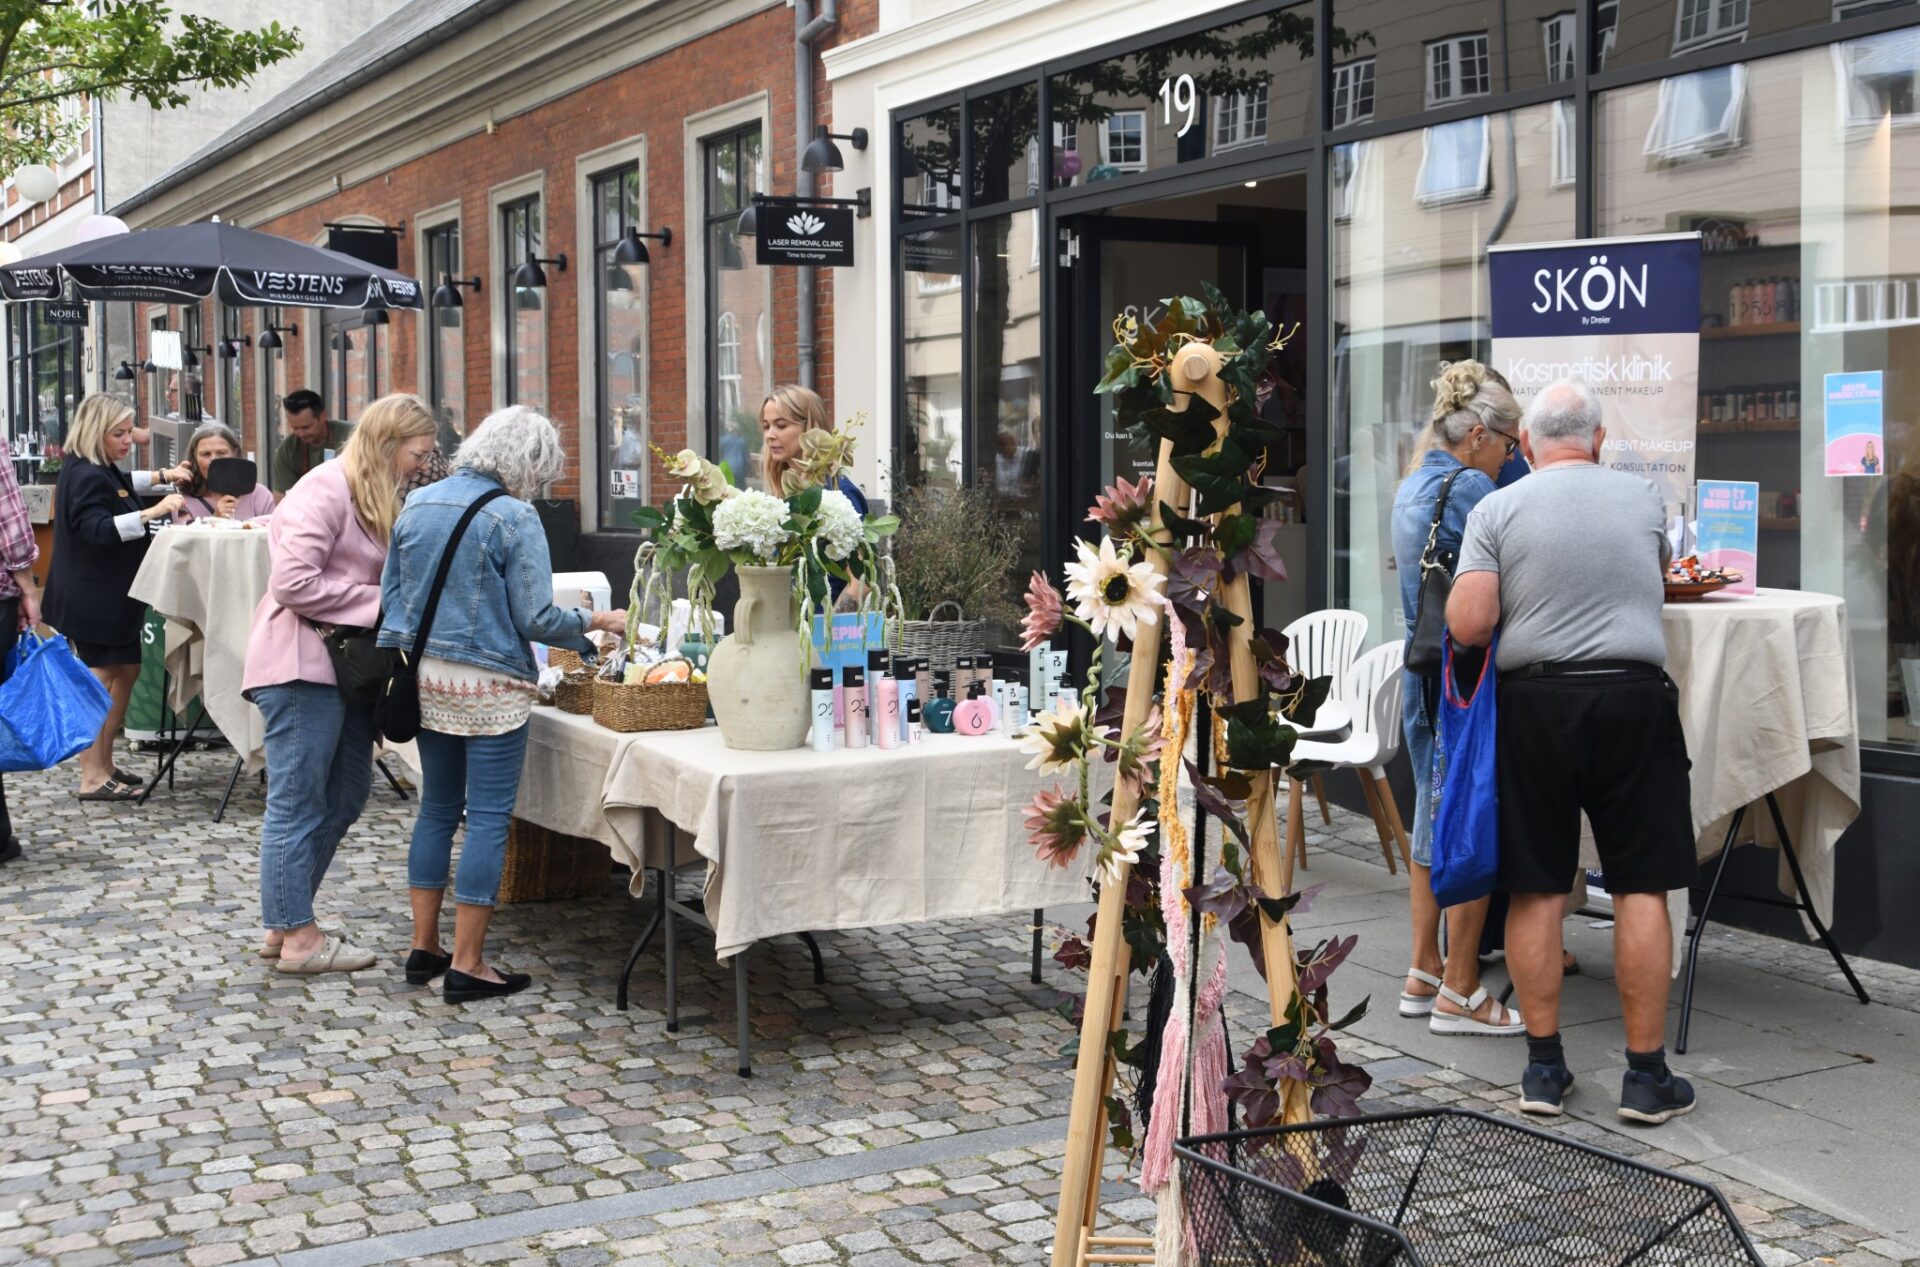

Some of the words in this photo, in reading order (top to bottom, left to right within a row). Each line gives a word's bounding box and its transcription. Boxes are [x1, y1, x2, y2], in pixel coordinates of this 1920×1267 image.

[1159, 73, 1195, 138] 19
[768, 238, 790, 246] LASER
[790, 239, 821, 247] REMOVAL
[821, 240, 844, 248] CLINIC
[806, 252, 826, 260] change
[1531, 255, 1648, 314] SKÖN
[49, 309, 82, 319] NOBEL
[1581, 316, 1590, 326] By
[1590, 315, 1611, 324] Dreier
[1508, 355, 1618, 382] Kosmetisk
[1621, 353, 1672, 382] klinik
[1591, 387, 1623, 396] ANENT
[1625, 387, 1664, 396] MAKEUP
[1602, 440, 1639, 452] ANENT
[1639, 440, 1694, 453] MAKEUP
[1610, 463, 1686, 473] KONSULTATION
[613, 471, 623, 483] TIL
[611, 484, 625, 496] LEJE
[940, 711, 952, 726] 7
[971, 714, 982, 729] 6
